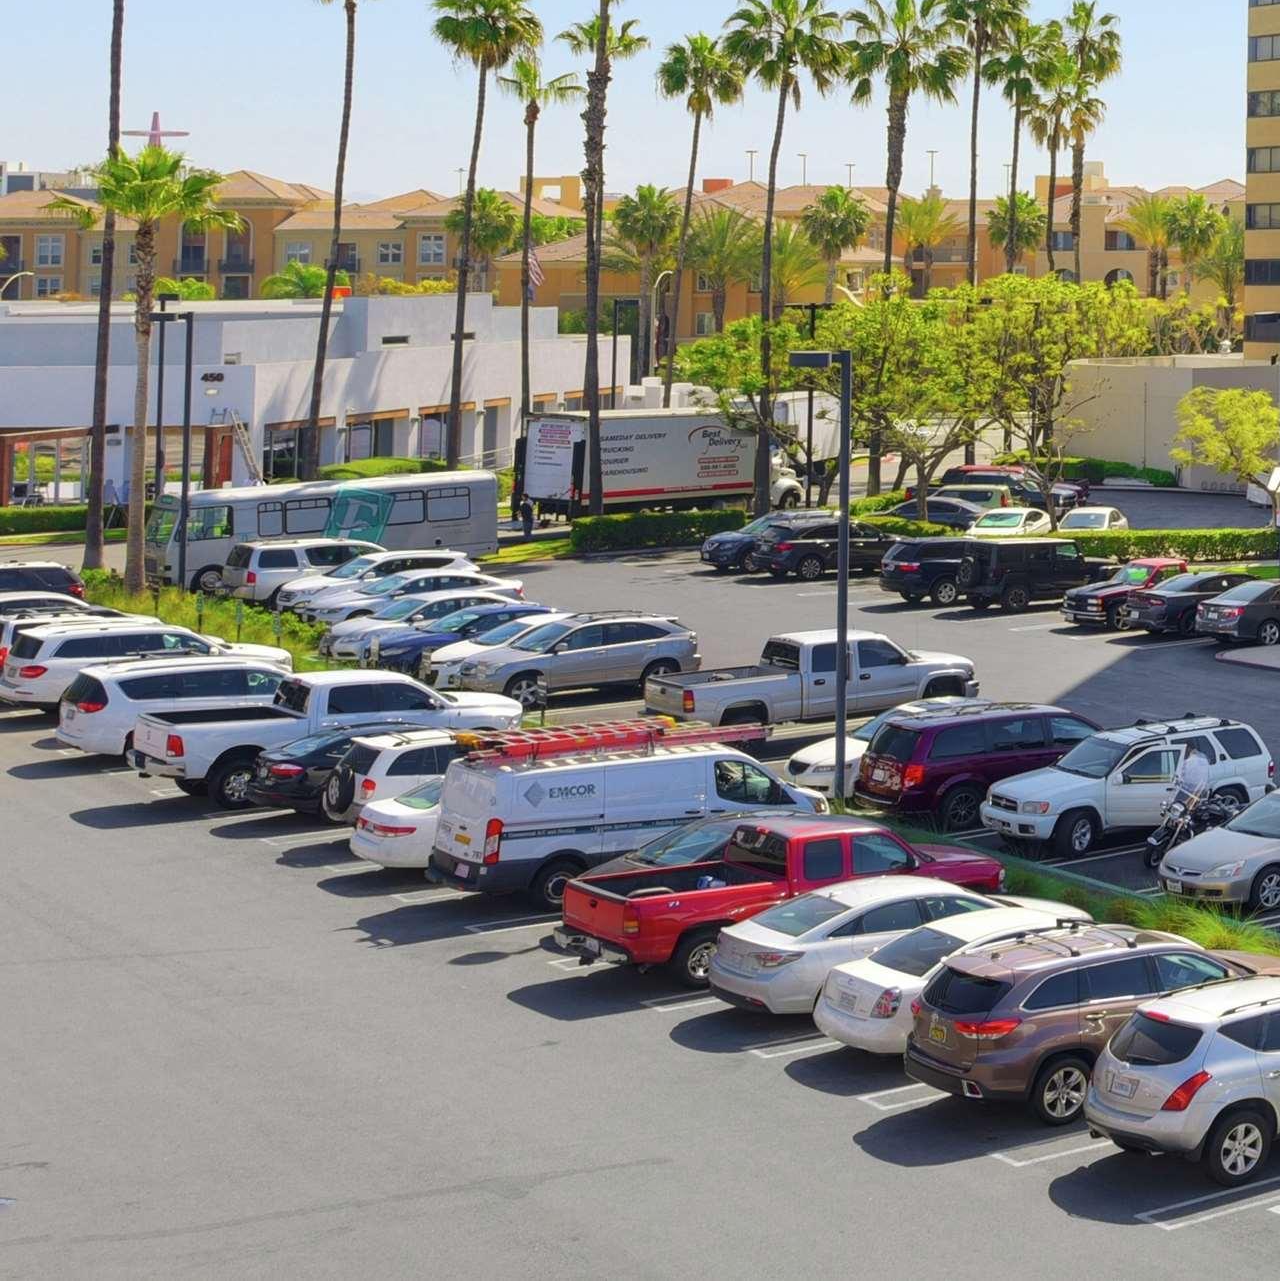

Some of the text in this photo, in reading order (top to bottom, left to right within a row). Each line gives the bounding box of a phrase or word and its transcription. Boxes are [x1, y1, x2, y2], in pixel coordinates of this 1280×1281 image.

[200, 372, 225, 383] 450
[634, 432, 667, 440] DELIVERY
[701, 429, 721, 438] Best
[708, 437, 743, 448] Delivery
[548, 783, 597, 799] EMCOR
